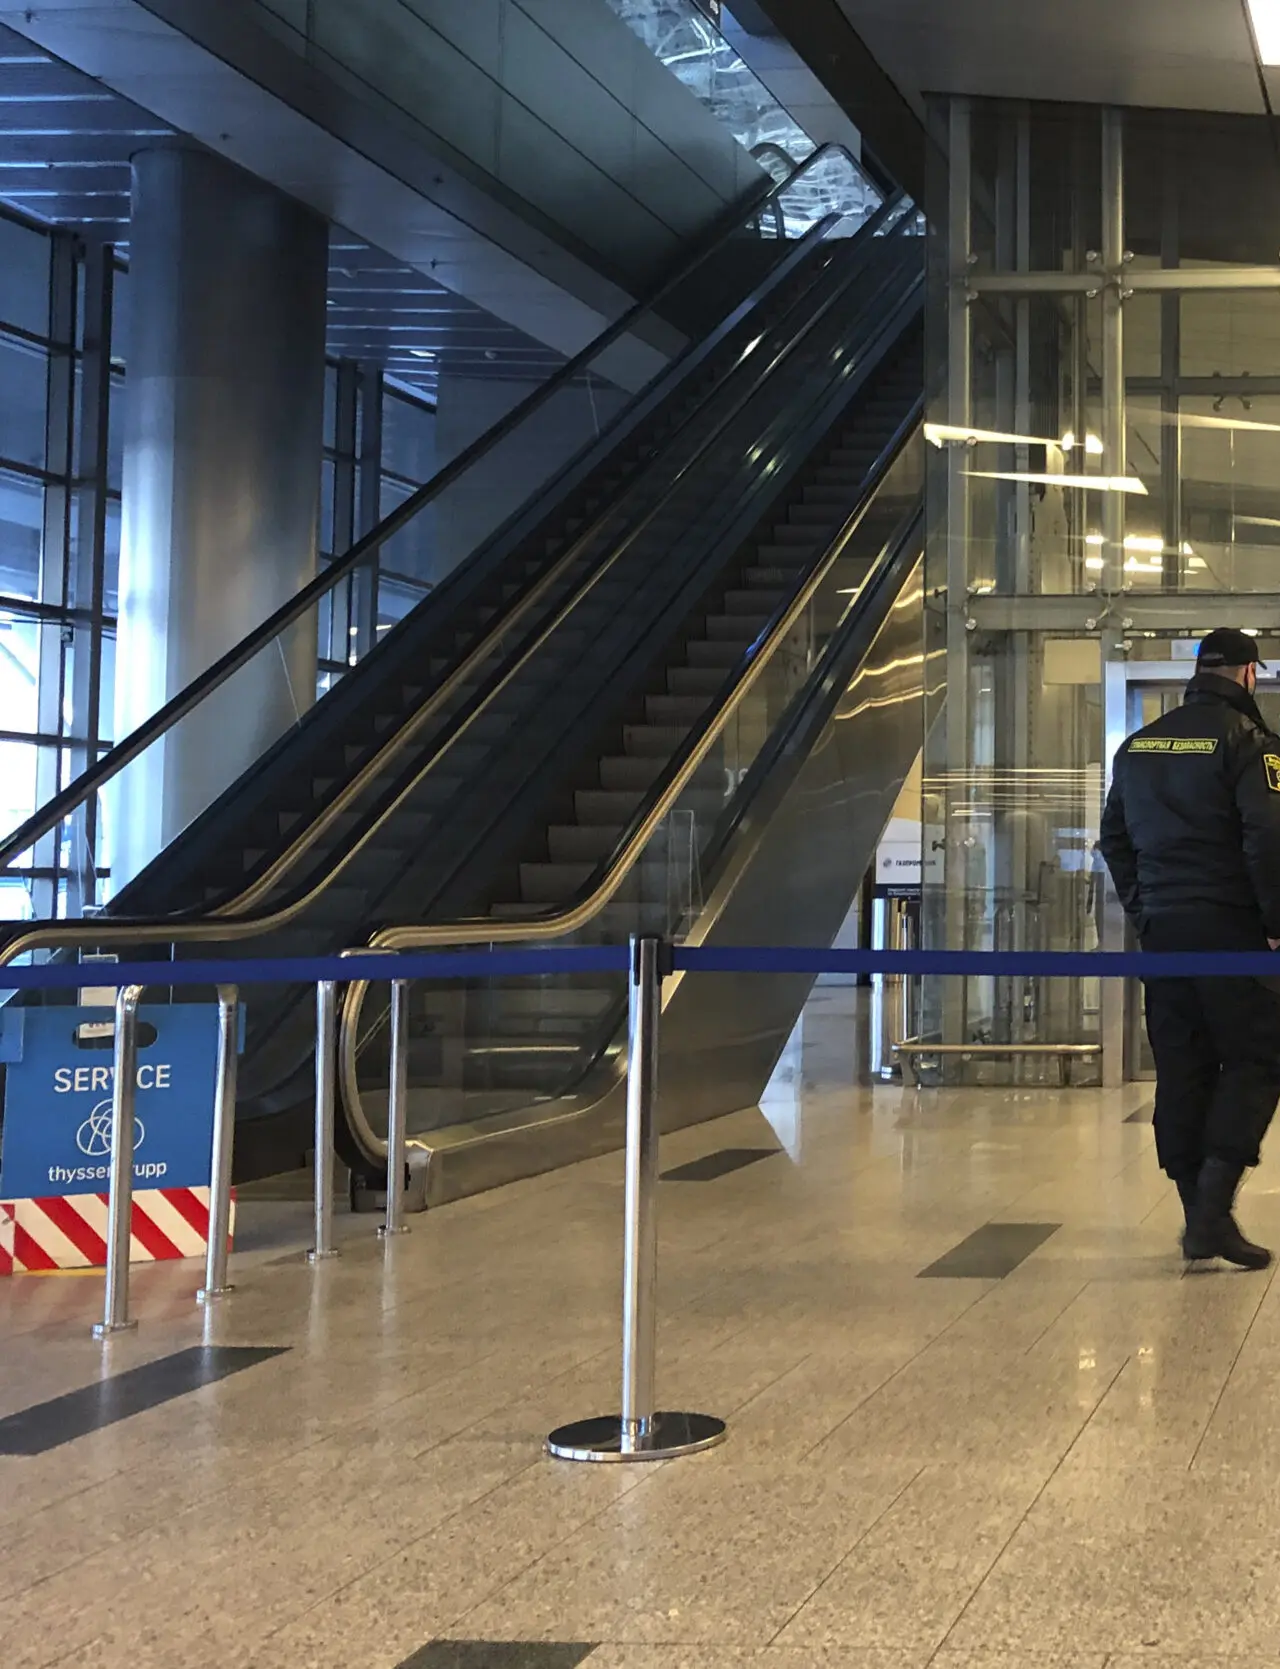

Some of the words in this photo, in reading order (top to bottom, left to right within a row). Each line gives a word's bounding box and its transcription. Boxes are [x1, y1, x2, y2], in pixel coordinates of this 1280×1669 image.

[895, 859, 937, 867] ГАЗПРОМК
[54, 1064, 172, 1093] SERCE
[48, 1161, 167, 1184] thysseupp
